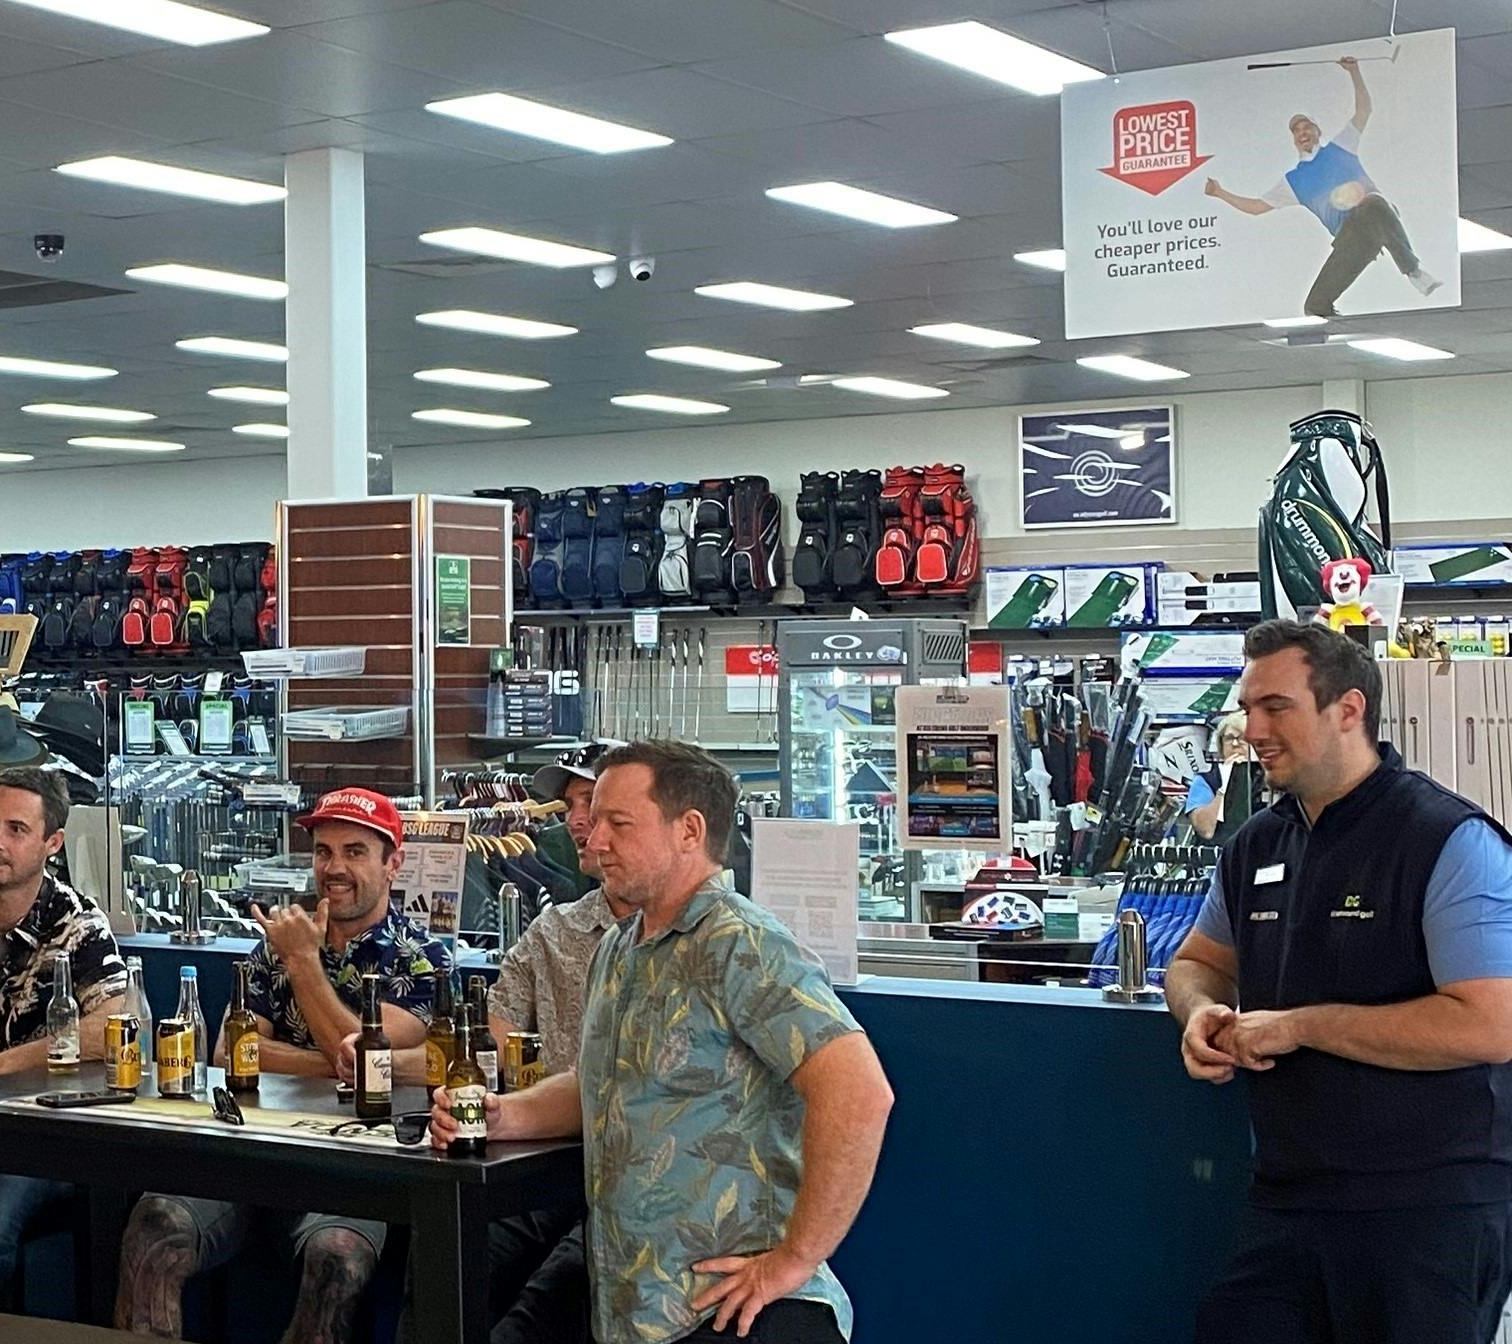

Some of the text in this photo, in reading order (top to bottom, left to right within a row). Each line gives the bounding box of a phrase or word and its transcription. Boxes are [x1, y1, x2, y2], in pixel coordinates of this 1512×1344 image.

[1119, 109, 1189, 135] LOWEST
[1119, 128, 1190, 157] PRICE
[1122, 154, 1188, 172] GUARANTEE
[1097, 213, 1218, 239] You'll love our
[1094, 233, 1221, 263] cheaper prices.
[1106, 255, 1210, 278] Guaranteed.
[1281, 498, 1332, 568] drummon
[811, 651, 874, 661] OAKLEY
[1452, 643, 1486, 654] PECIAL
[320, 794, 377, 817] THRASHER
[418, 822, 450, 837] LEAGUE
